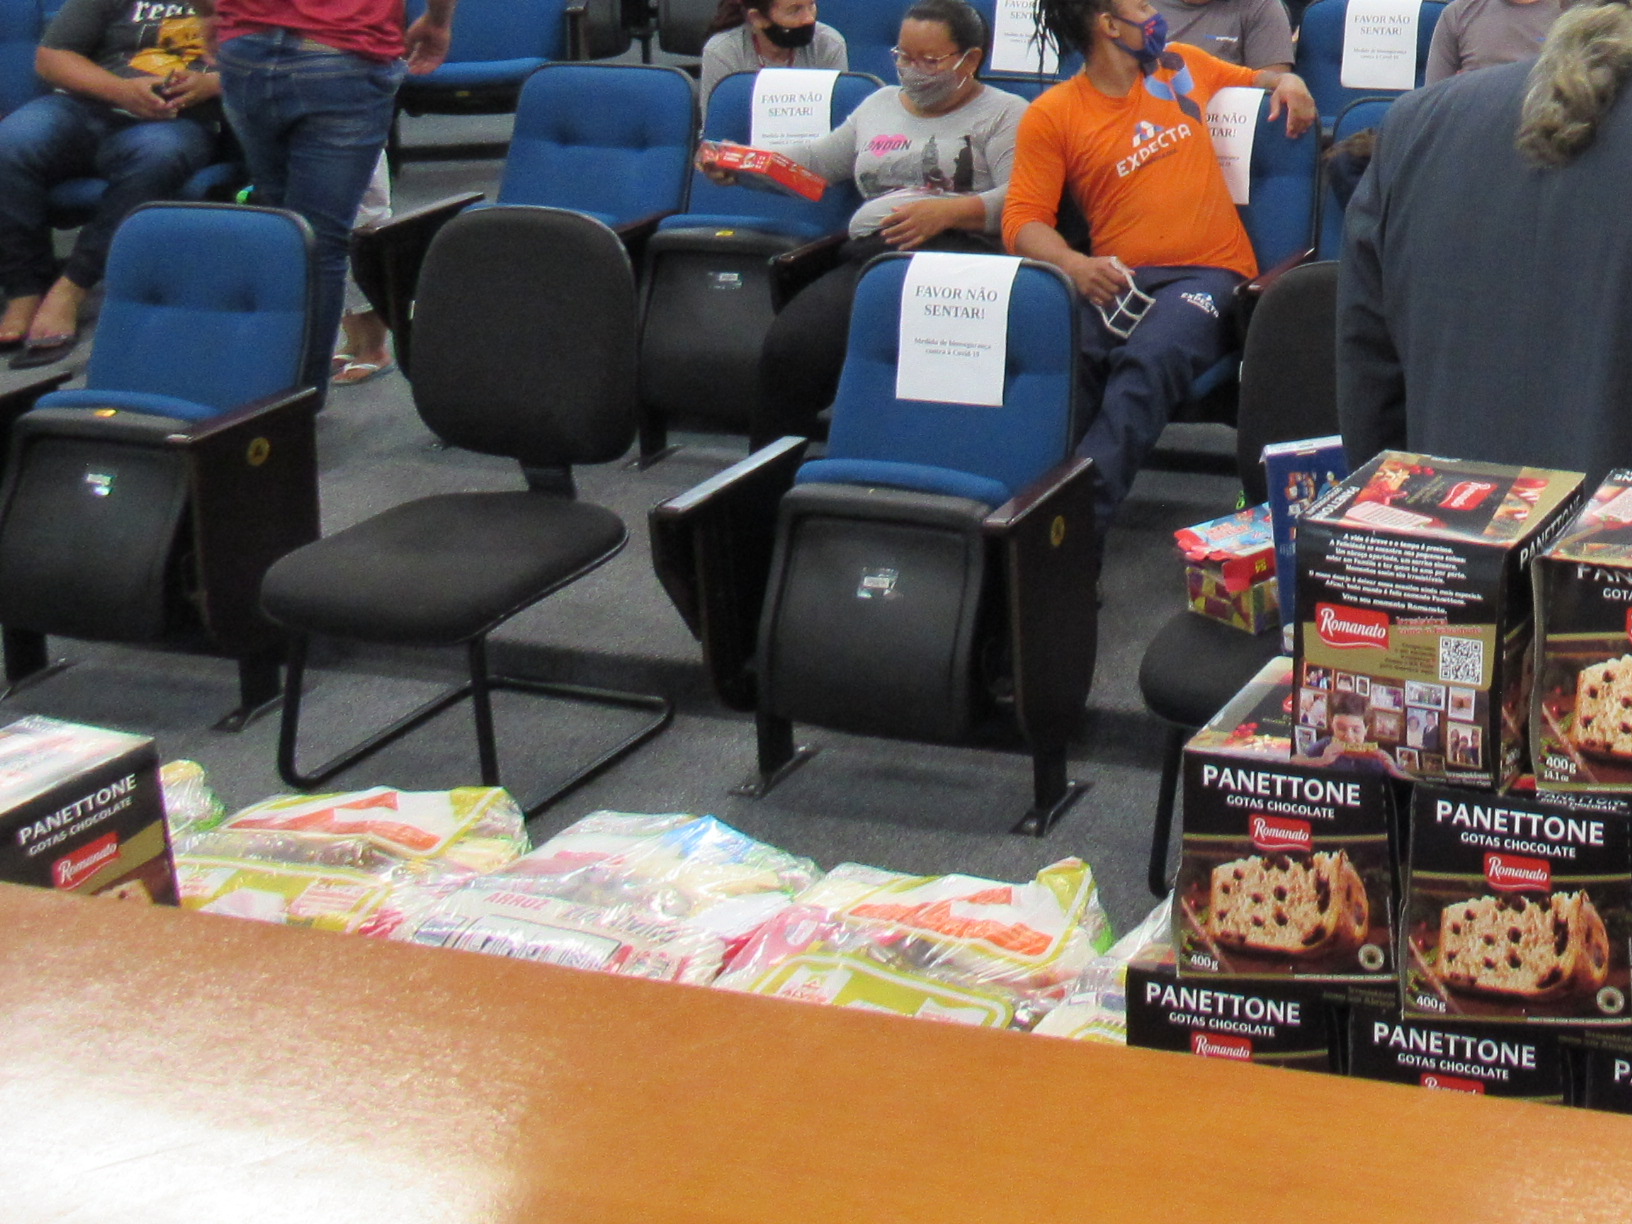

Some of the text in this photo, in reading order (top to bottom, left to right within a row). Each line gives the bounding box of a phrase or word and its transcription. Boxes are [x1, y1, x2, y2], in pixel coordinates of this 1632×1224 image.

[1354, 15, 1410, 25] FAVOR NÃO
[761, 92, 823, 104] FAVOR NÃO
[768, 106, 813, 117] SENTAR!
[1222, 112, 1247, 124] NÃO
[915, 285, 997, 302] FAVOR NÃO
[924, 304, 985, 319] SENTAR!
[1319, 607, 1387, 640] Romanato
[1203, 765, 1361, 806] PANETTONE
[18, 773, 138, 845] PANETTONE
[1227, 794, 1335, 820] GOTAS CHOCOLATE
[29, 796, 133, 857] GOTAS CHOCOLATE
[1254, 817, 1311, 842] Romanato
[1437, 800, 1604, 844] PANETTONE
[1460, 832, 1576, 859] GOTAS CHOCOLATE
[58, 843, 118, 884] Romanato
[1488, 856, 1549, 883] Romanato
[483, 891, 552, 911] ARROZ
[1147, 982, 1301, 1025] PANETTONE
[1168, 1011, 1276, 1038] GOTAS CHOCOLATE
[1195, 1035, 1251, 1059] Romanato
[1374, 1022, 1537, 1068] PANETTONE
[1397, 1053, 1510, 1082] GOTAS CHOCOLATE
